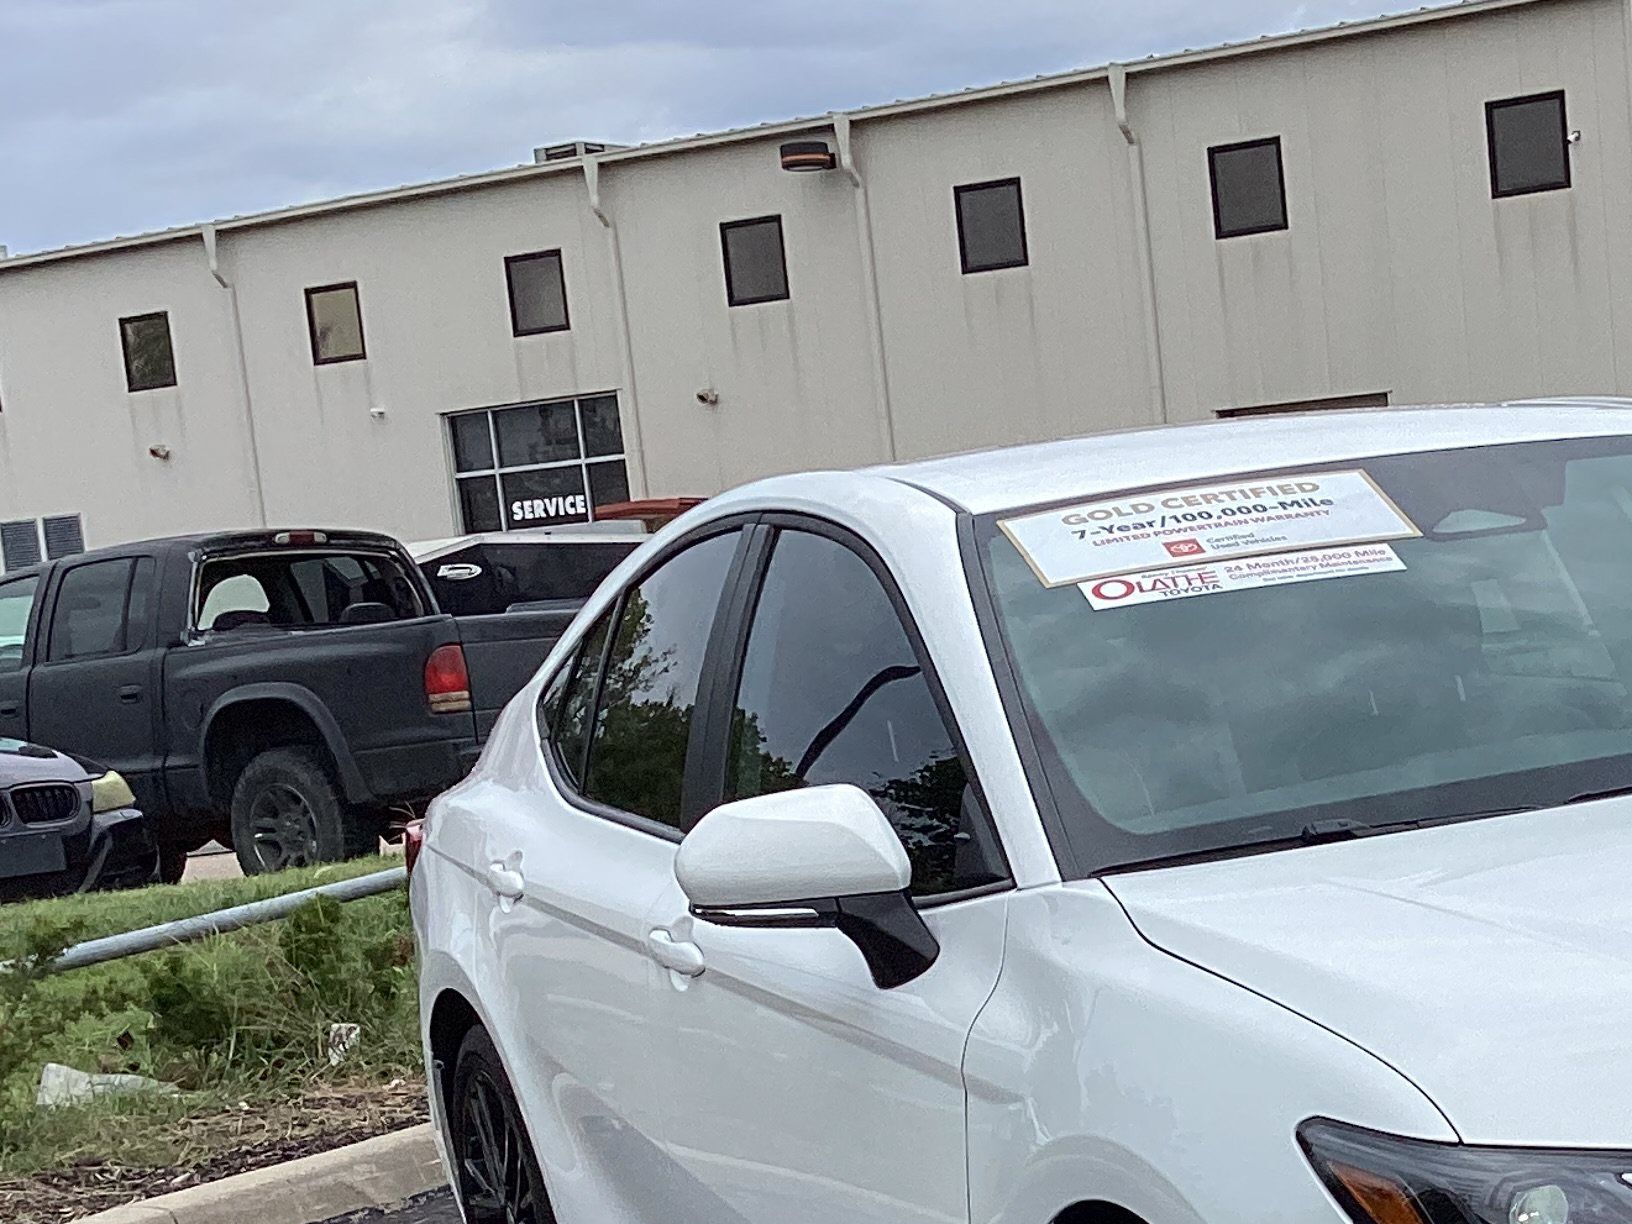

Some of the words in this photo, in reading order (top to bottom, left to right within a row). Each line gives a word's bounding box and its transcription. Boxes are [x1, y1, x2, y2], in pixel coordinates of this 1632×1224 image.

[511, 495, 587, 521] SERVICE
[1061, 502, 1155, 526] GOLD
[1160, 482, 1320, 509] CERTIFIED
[1070, 497, 1335, 540] 7-Year/100,000-Mile
[1092, 532, 1151, 547] LIMITED
[1153, 519, 1250, 537] POWERTRAIN
[1251, 508, 1331, 524] WARRANTY
[1206, 532, 1256, 544] Certified
[1209, 541, 1241, 551] Used
[1242, 535, 1289, 546] Vehicles
[1223, 565, 1244, 574] 24
[1353, 548, 1387, 558] Mile
[1320, 555, 1394, 570] Maintenance
[1091, 570, 1221, 601] OLATHE
[1159, 583, 1224, 598] TOYOTA
